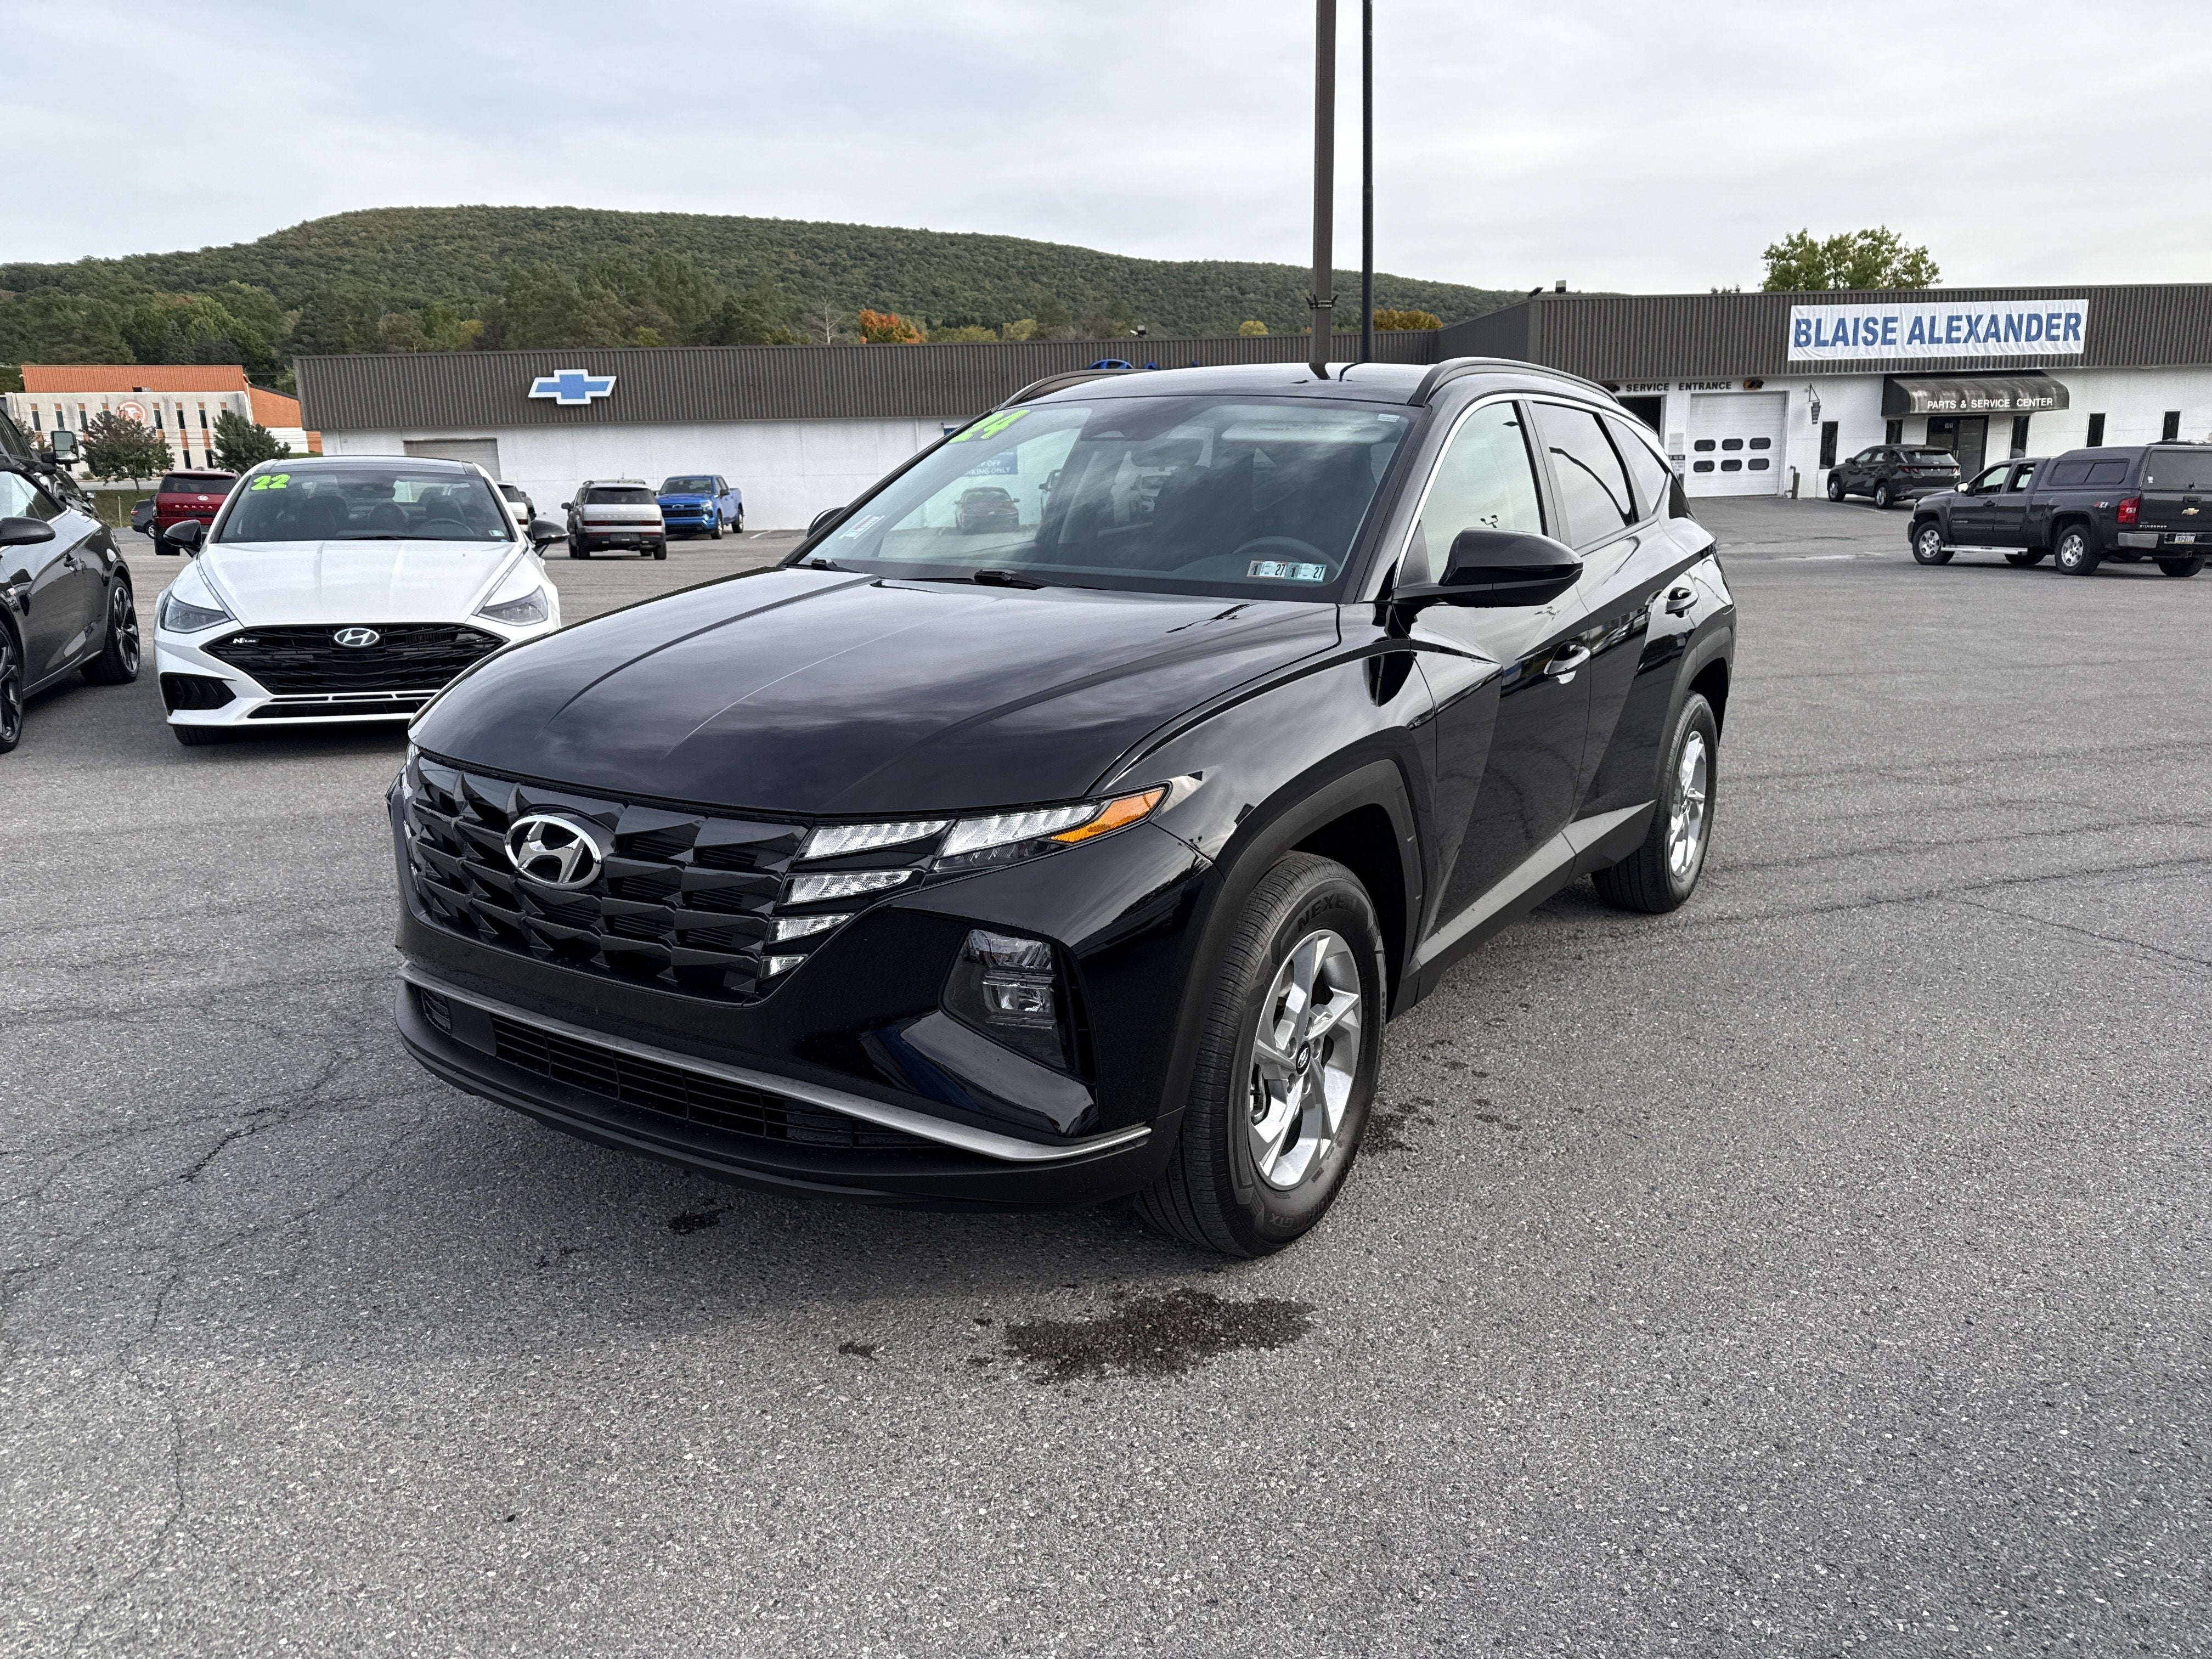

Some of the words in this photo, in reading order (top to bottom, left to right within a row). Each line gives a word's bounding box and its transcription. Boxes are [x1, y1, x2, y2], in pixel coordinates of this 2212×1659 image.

[1793, 316, 1899, 347] BLAISE
[1906, 312, 2083, 345] ALEXANDER
[1626, 383, 1670, 392] SERVICE
[1678, 381, 1732, 391] ENTRANCE
[1927, 400, 1956, 409] PARTS
[1960, 400, 1967, 408] &
[1971, 399, 2011, 408] SERVICE
[2016, 398, 2053, 407] CENTER
[251, 474, 290, 490] 22
[1275, 563, 1286, 577] 27
[1313, 566, 1324, 579] 27
